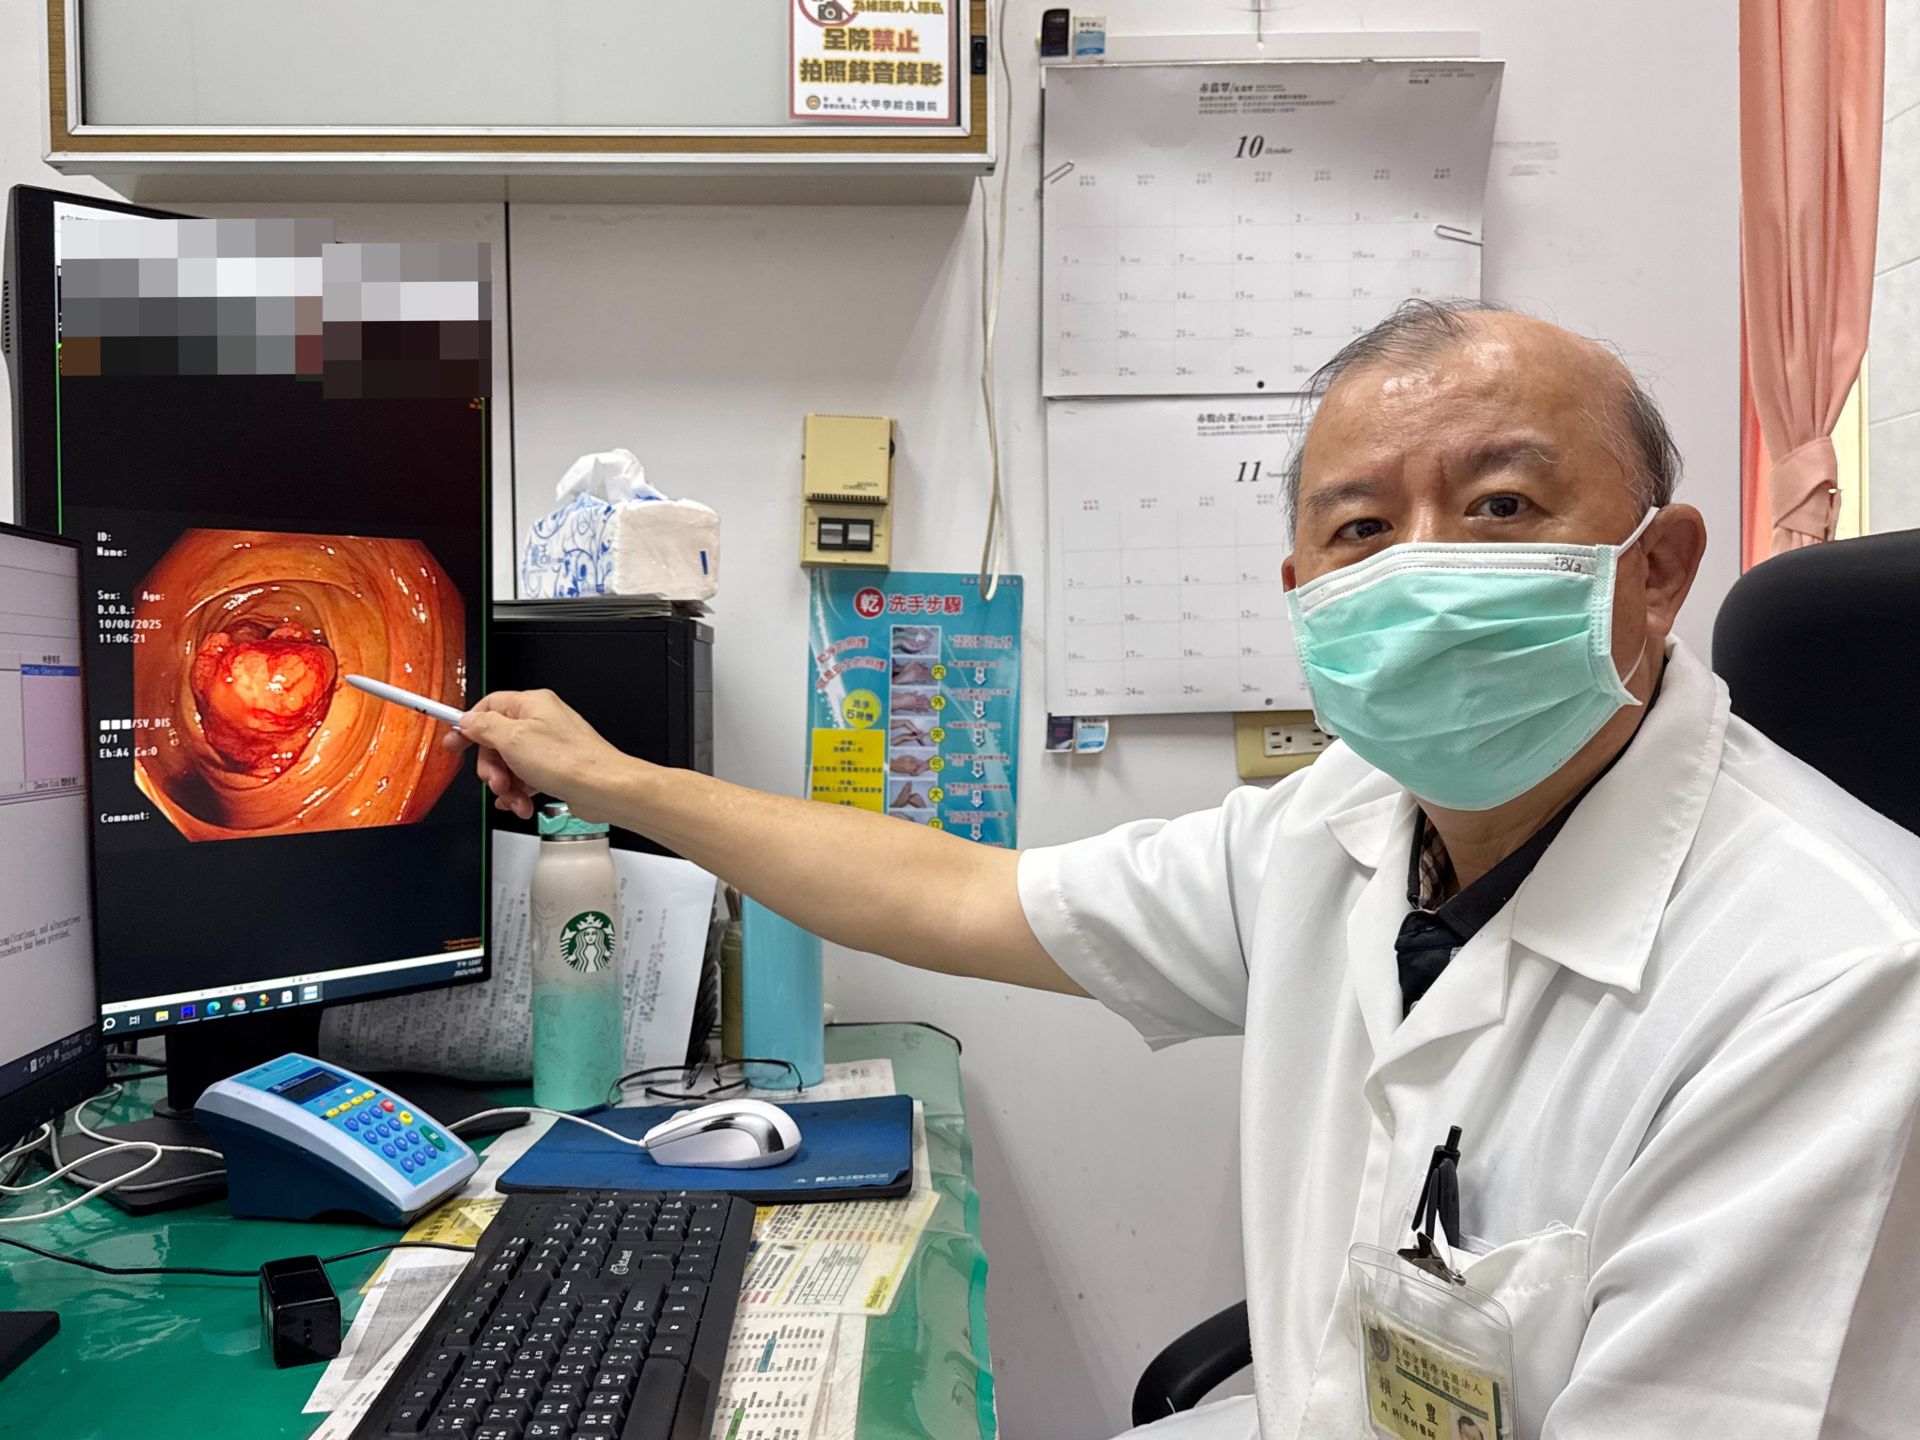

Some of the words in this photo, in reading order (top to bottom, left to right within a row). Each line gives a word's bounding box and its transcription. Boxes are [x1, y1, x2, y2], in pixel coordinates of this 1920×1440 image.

[824, 28, 919, 53] 全院禁止
[800, 59, 943, 86] 拍照錄音錄影
[1234, 135, 1264, 159] 10
[1234, 460, 1261, 482] 11
[97, 532, 112, 542] ID:
[97, 547, 127, 557] Name:
[97, 590, 121, 600] Sex:
[142, 591, 165, 602] Age:
[860, 593, 881, 613] 乾
[888, 594, 963, 615] 洗手步驟
[98, 605, 135, 615] D.O.B.:
[99, 619, 162, 630] 10/08/2025
[99, 634, 146, 644] 11:06:21
[99, 734, 118, 744] 0/1
[101, 812, 150, 823] Comment:
[1394, 1344, 1482, 1396] 綜合醫療社團法人
